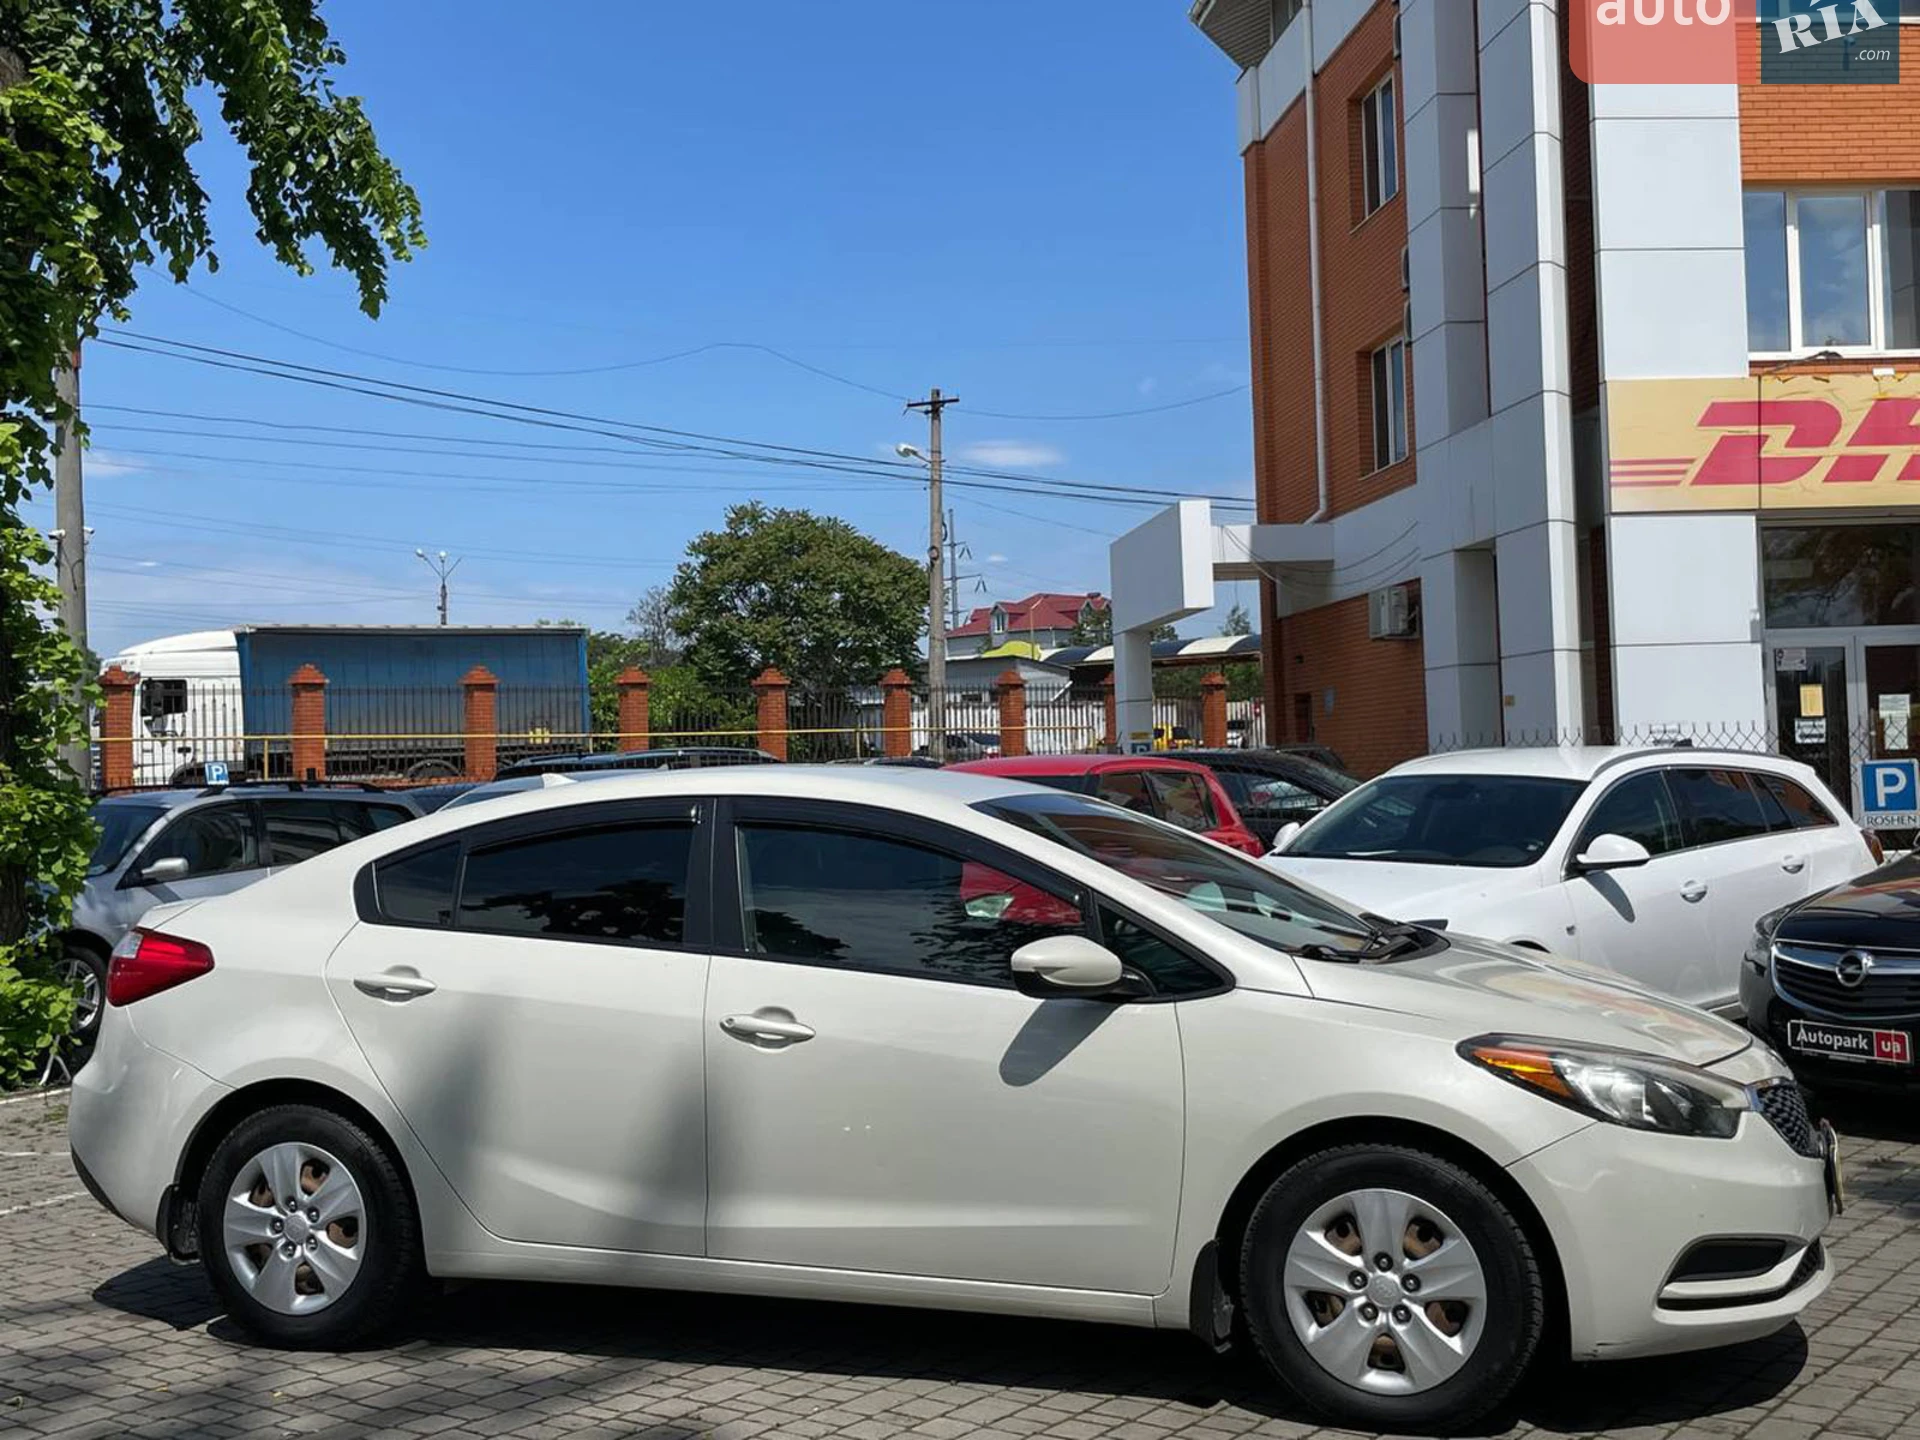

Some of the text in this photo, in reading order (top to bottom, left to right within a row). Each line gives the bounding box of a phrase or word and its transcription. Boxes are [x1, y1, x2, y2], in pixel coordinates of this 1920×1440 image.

[211, 765, 223, 781] P
[1875, 767, 1907, 808] P
[1866, 815, 1917, 826] ROSHEN
[1796, 1028, 1868, 1050] Autopark
